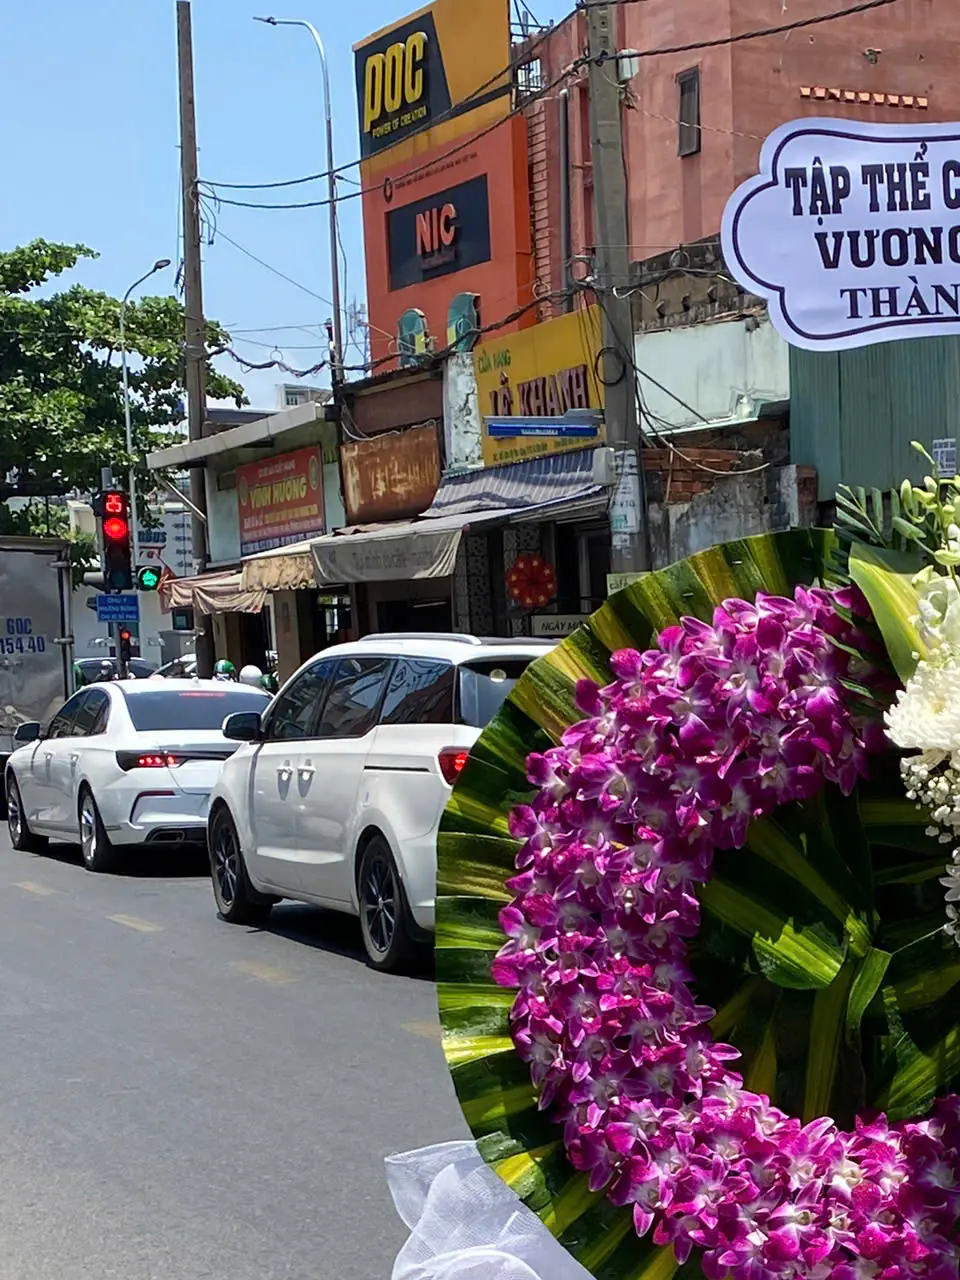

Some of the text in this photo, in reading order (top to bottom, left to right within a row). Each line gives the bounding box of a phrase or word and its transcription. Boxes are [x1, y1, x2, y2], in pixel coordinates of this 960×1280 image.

[392, 118, 400, 130] OF
[400, 105, 427, 126] CREATION
[784, 155, 851, 226] TẬP
[861, 140, 931, 212] THỂ
[416, 203, 457, 256] NIC
[6, 617, 33, 635] 60C
